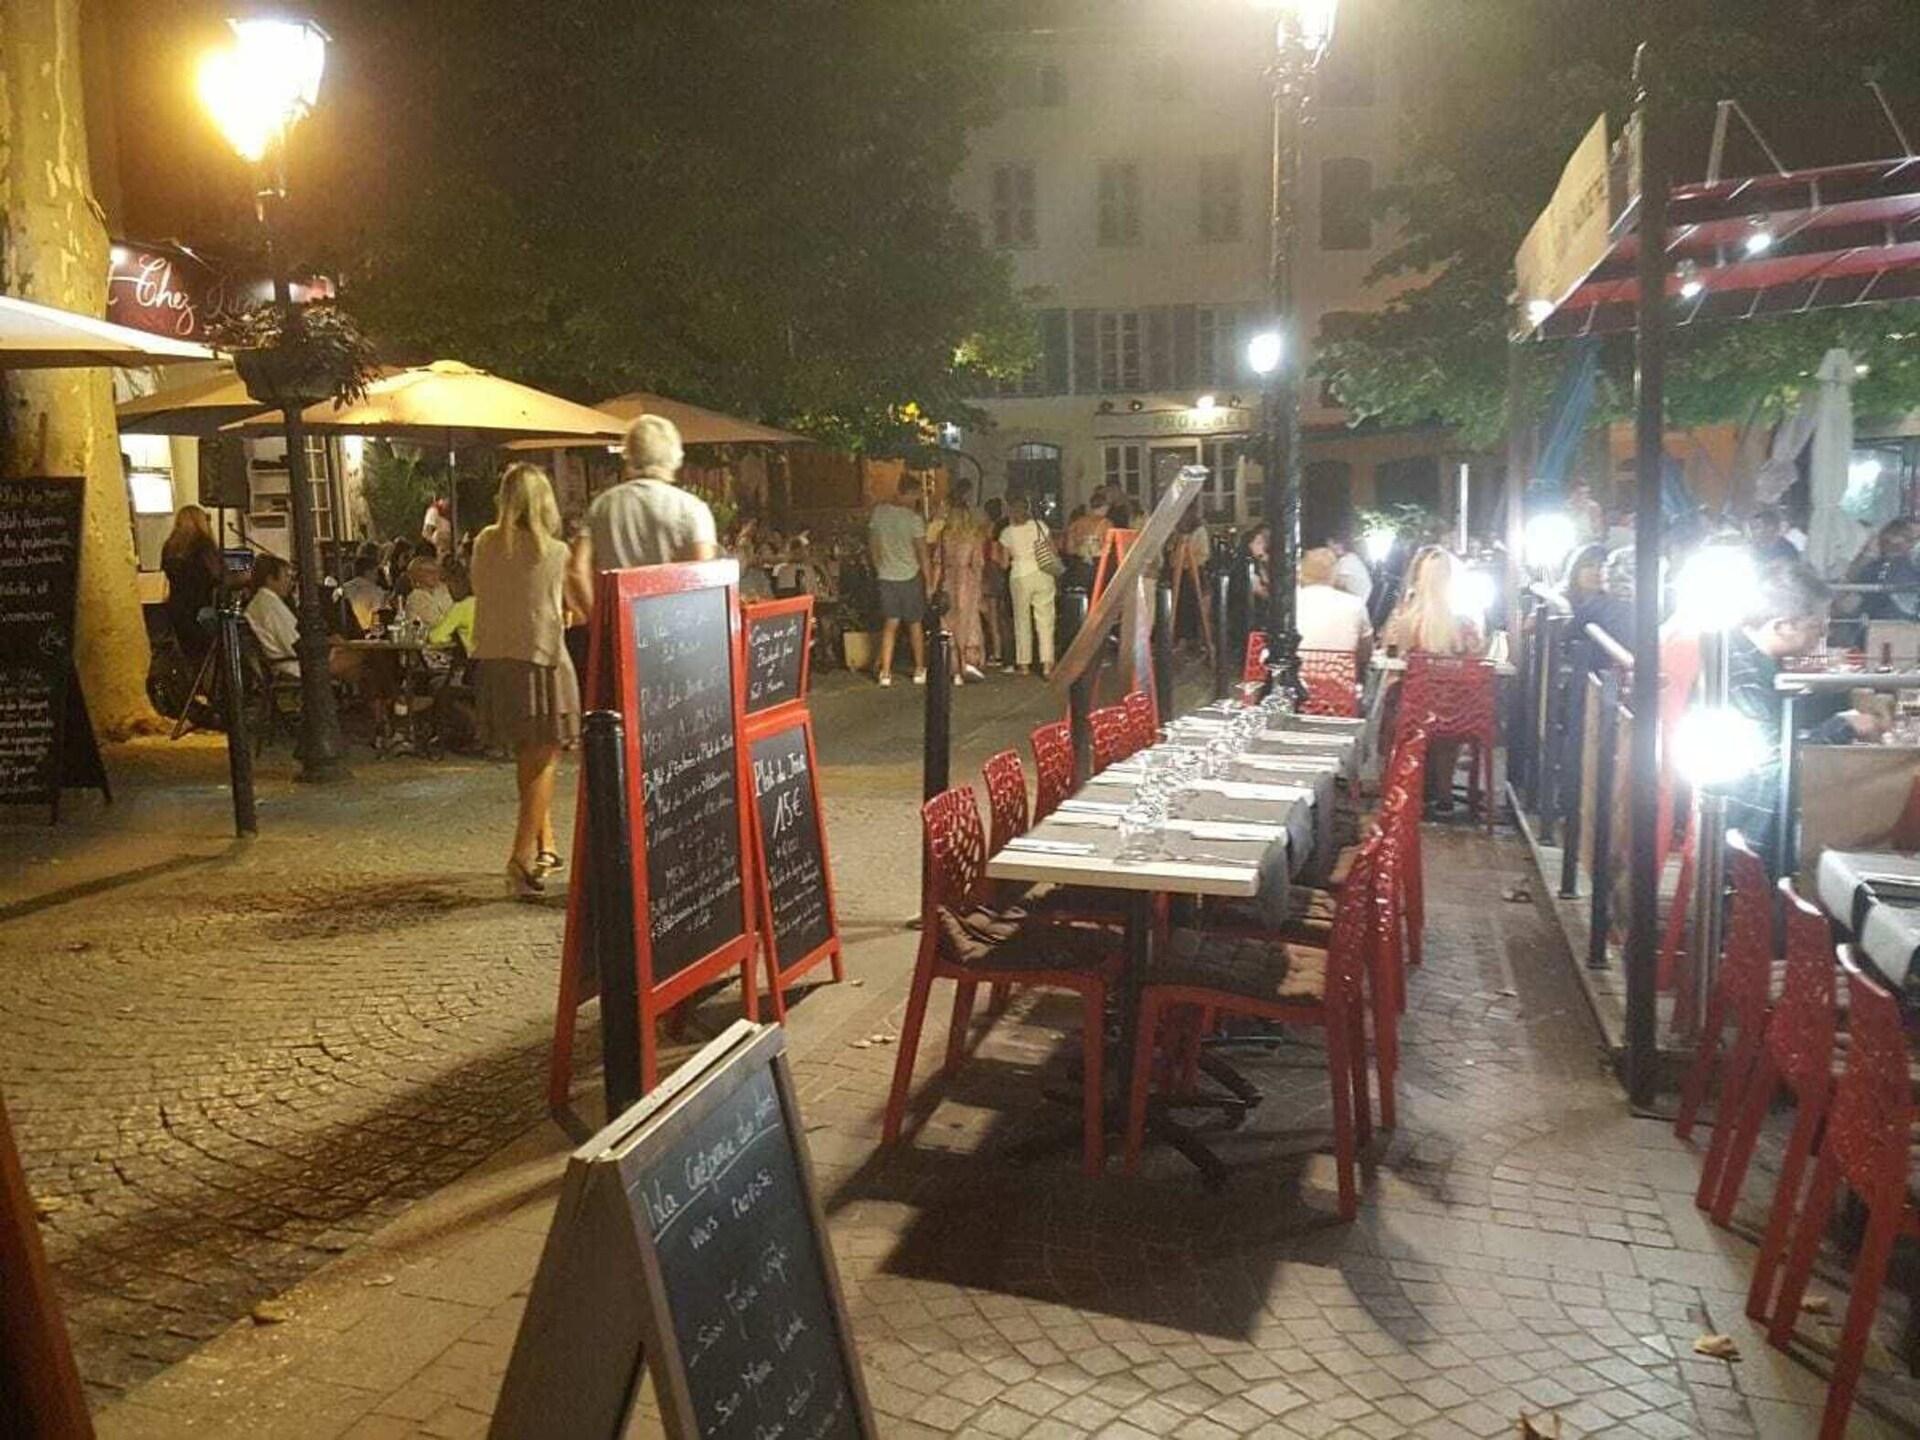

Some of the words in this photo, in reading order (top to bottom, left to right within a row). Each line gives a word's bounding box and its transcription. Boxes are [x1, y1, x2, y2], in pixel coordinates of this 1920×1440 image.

[137, 254, 197, 335] Chez
[753, 758, 775, 797] Plat
[786, 752, 807, 780] Jour
[771, 785, 805, 841] 15€
